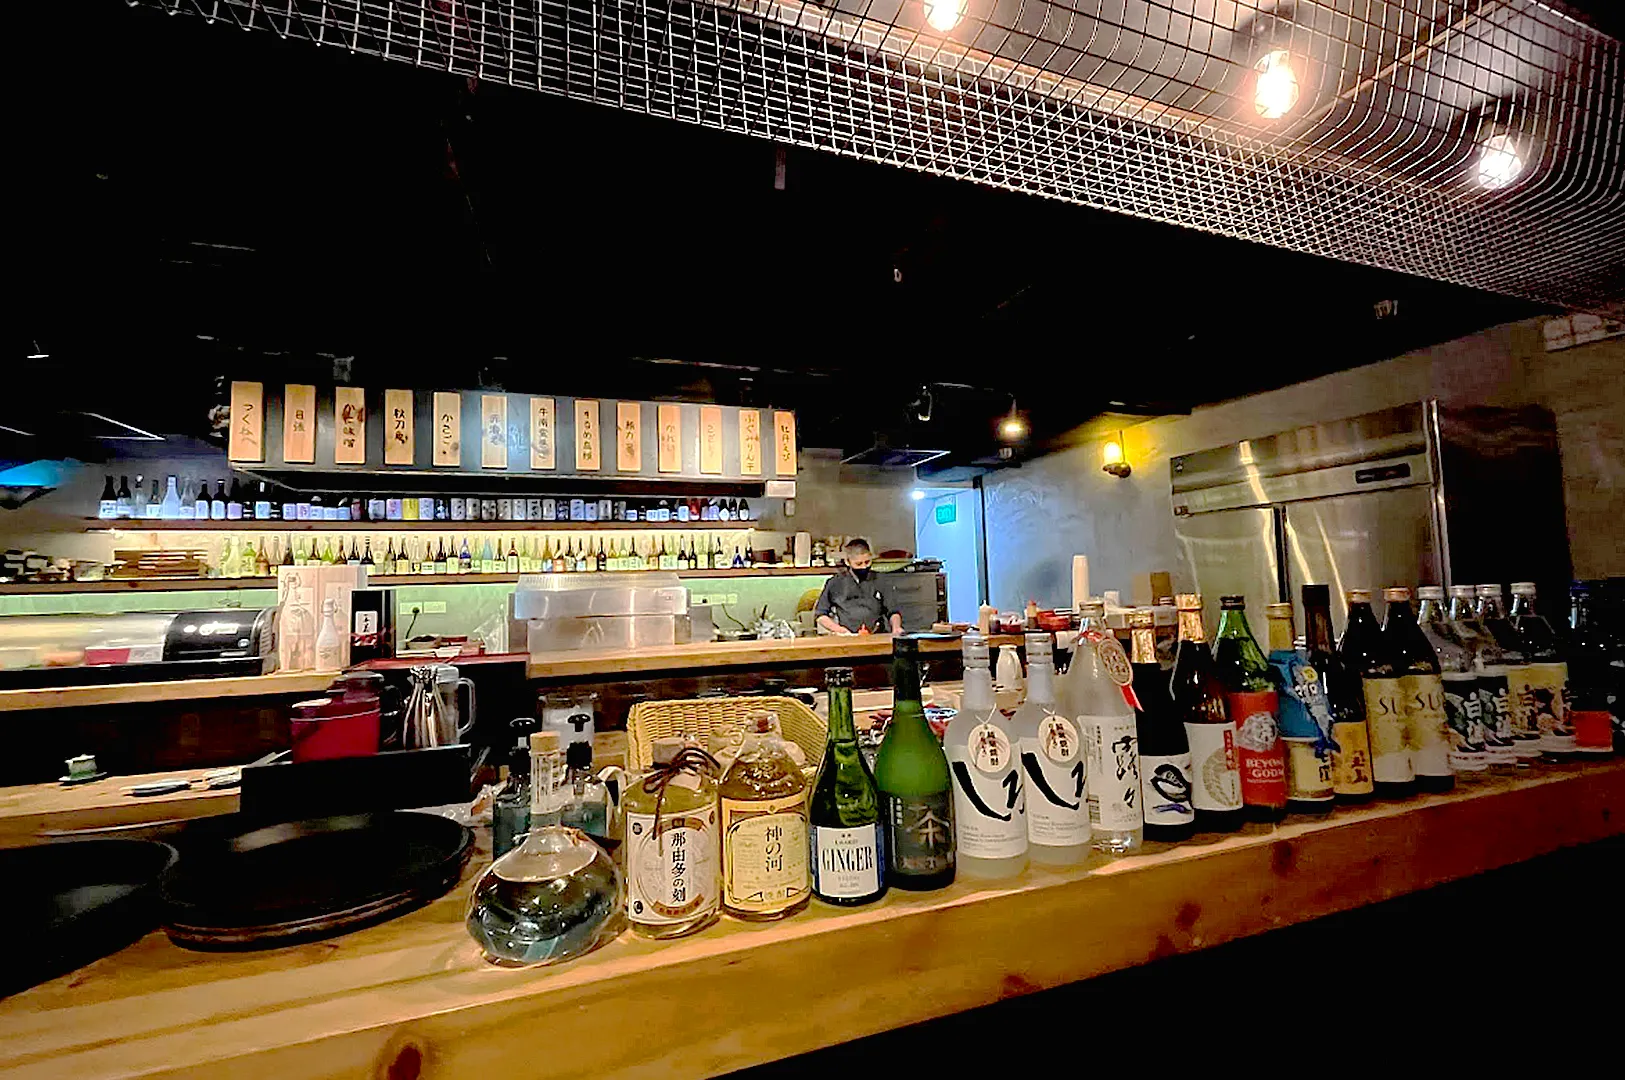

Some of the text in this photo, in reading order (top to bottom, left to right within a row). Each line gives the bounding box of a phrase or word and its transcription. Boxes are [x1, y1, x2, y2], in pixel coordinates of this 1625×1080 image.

[671, 831, 687, 902] 那由多の刻
[765, 825, 783, 872] 神の河
[822, 846, 873, 872] GINGER
